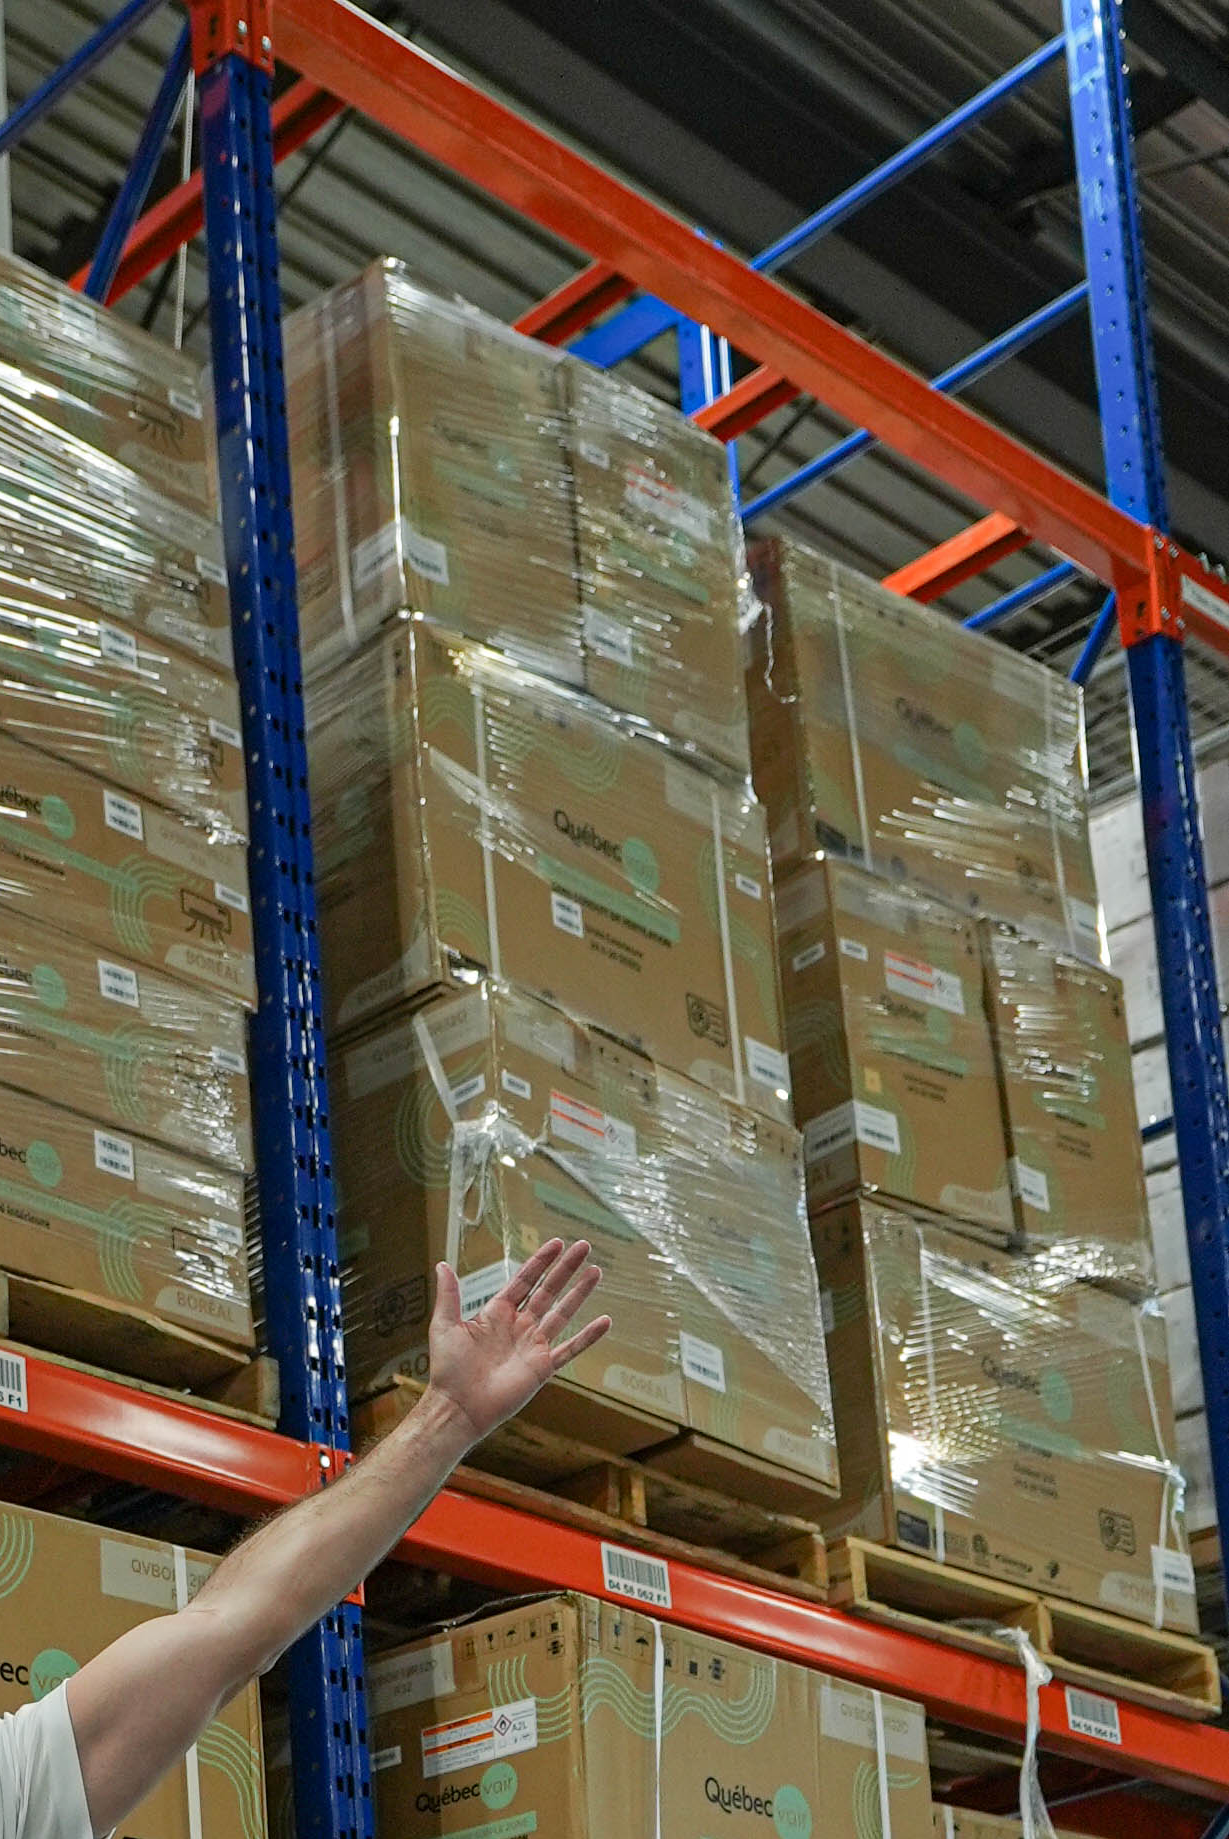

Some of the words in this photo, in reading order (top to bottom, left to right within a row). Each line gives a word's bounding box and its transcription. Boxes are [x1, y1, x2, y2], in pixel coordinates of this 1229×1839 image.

[8, 1394, 22, 1408] F1
[415, 1783, 480, 1813] Québec
[705, 1776, 773, 1818] Québec
